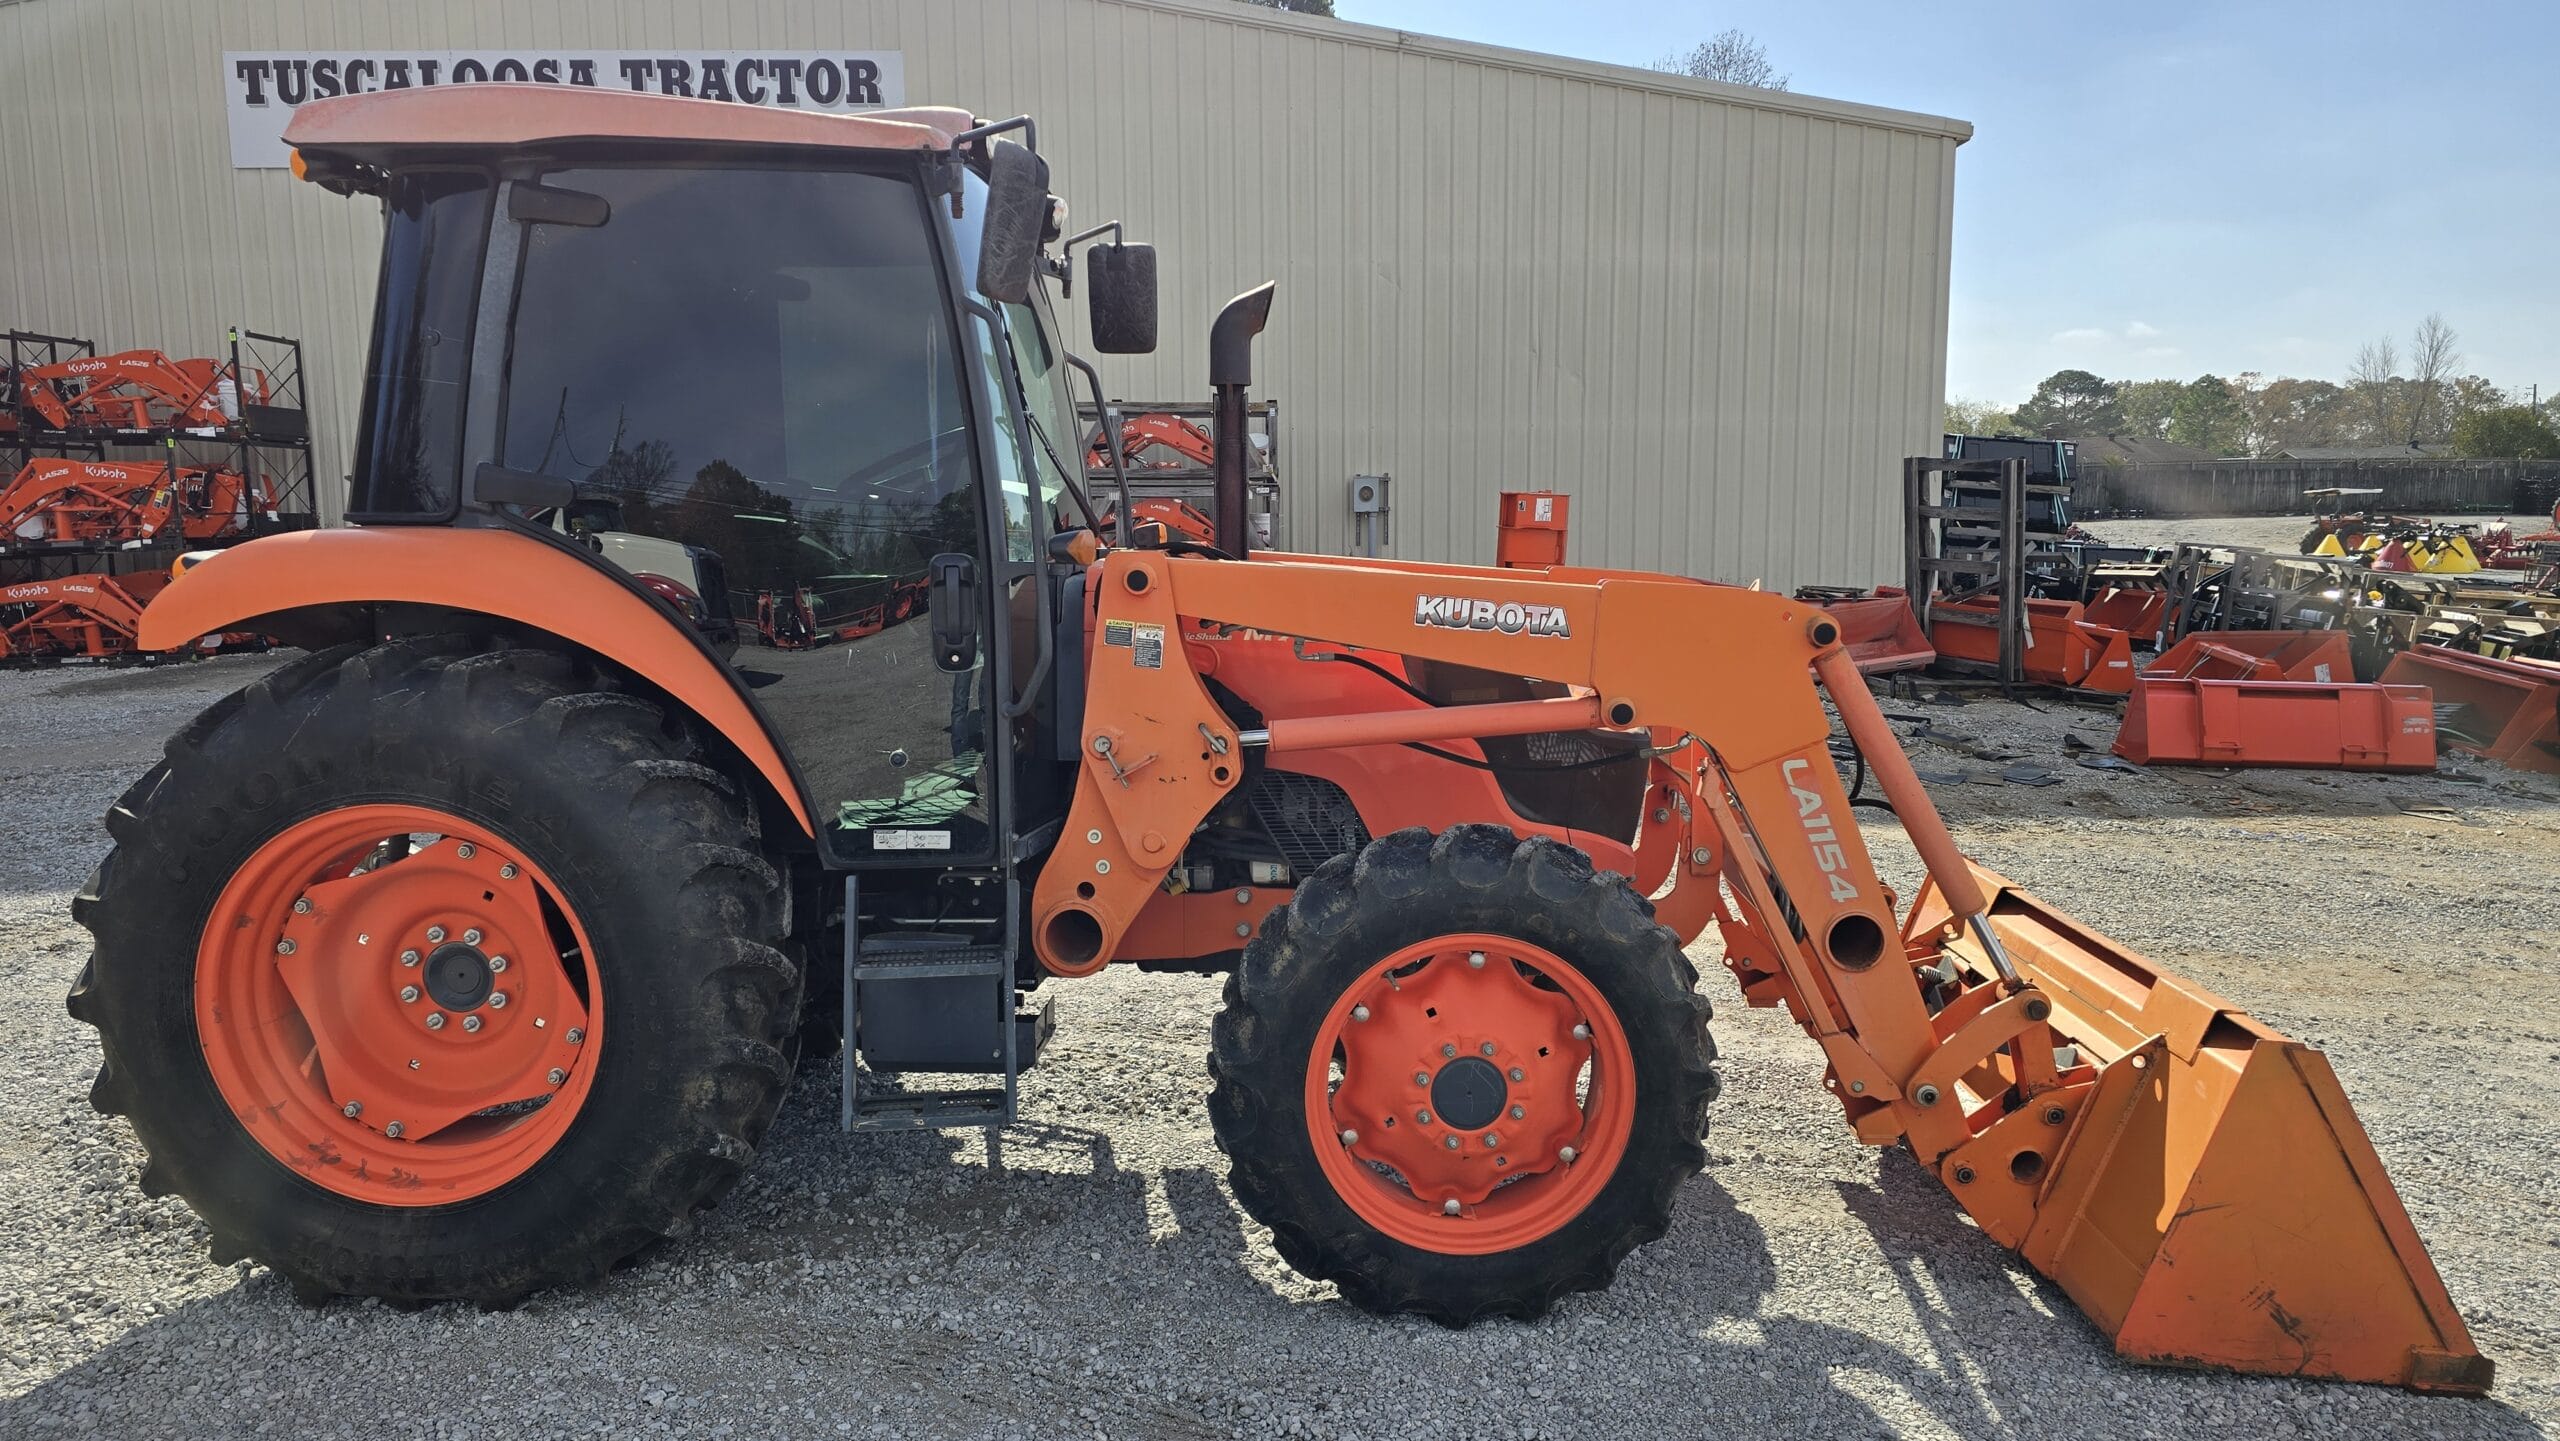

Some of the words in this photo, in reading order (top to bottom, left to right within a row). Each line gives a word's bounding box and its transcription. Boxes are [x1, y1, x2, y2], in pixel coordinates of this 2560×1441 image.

[620, 58, 885, 106] TRACTOR
[67, 360, 107, 373] Kubota
[85, 465, 127, 479] Kubota
[7, 585, 49, 598] Kubota
[1414, 593, 1571, 639] KUBOTA
[1782, 758, 1859, 903] LA1154
